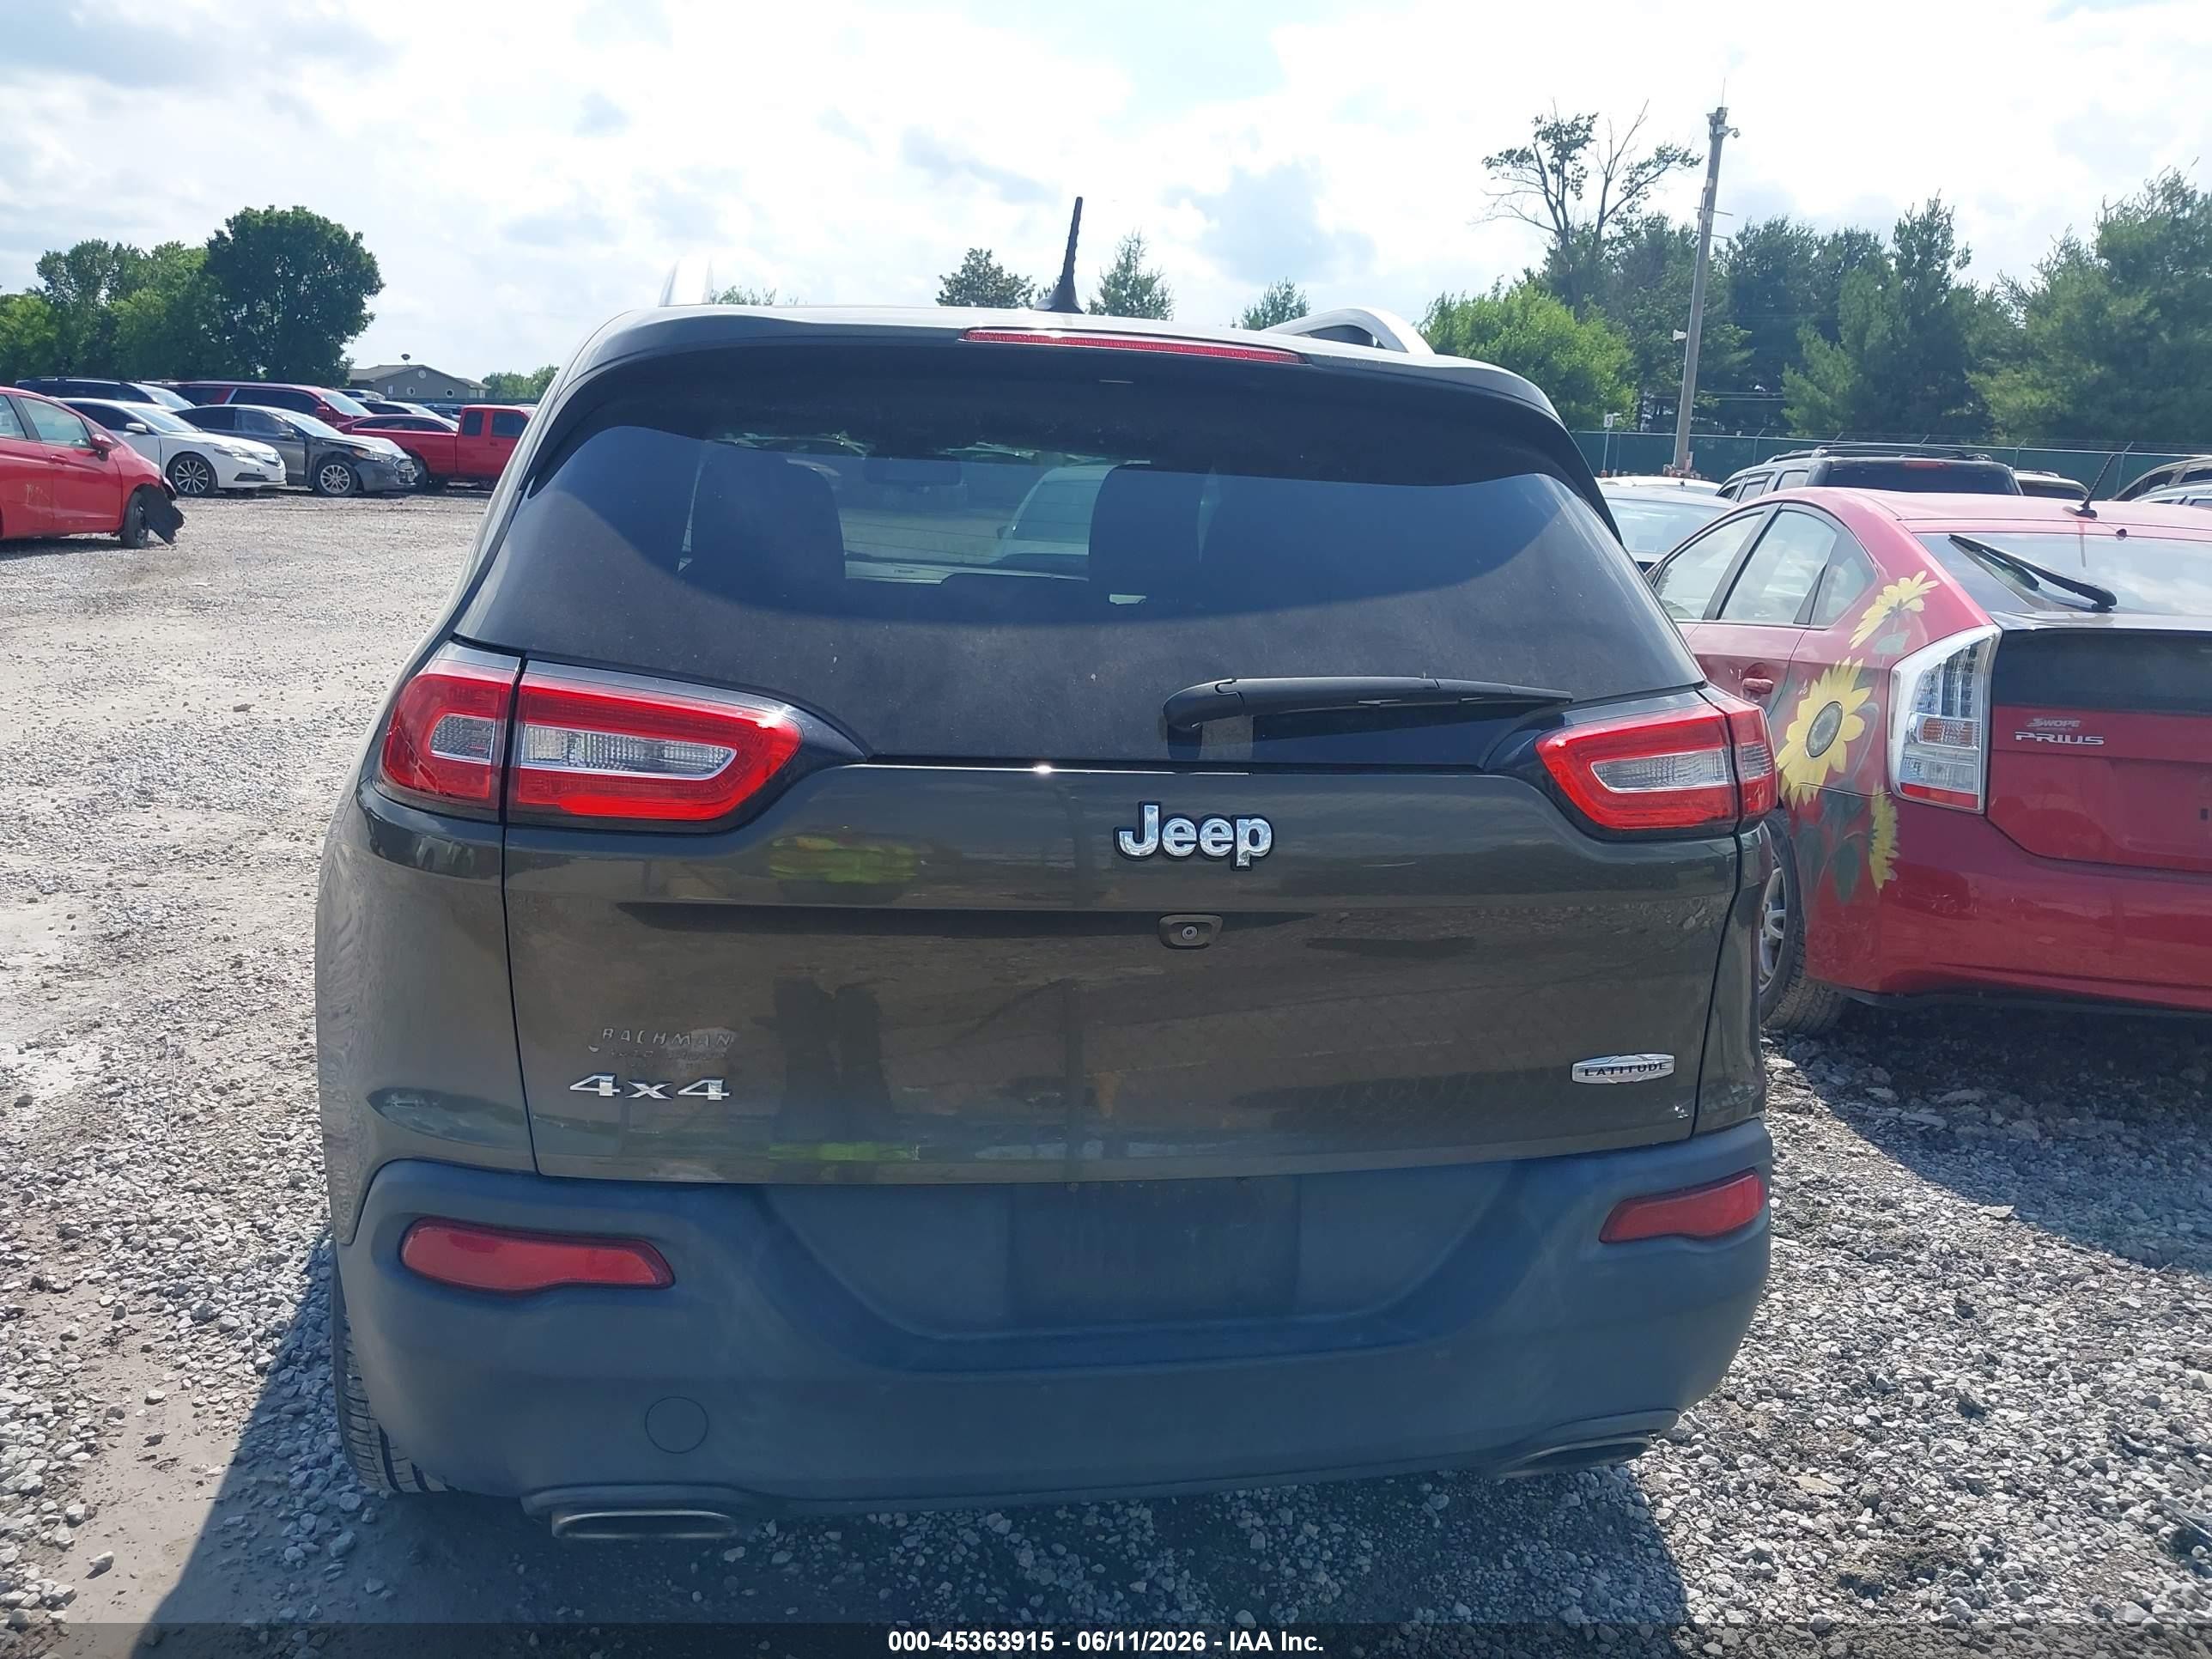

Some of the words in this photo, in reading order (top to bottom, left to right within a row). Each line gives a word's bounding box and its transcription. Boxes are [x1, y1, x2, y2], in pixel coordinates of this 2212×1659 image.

[2014, 732, 2105, 745] PRIUS
[1117, 804, 1273, 868] Jeep
[1584, 1062, 1668, 1077] LATITUDE
[569, 1073, 730, 1101] 4x4
